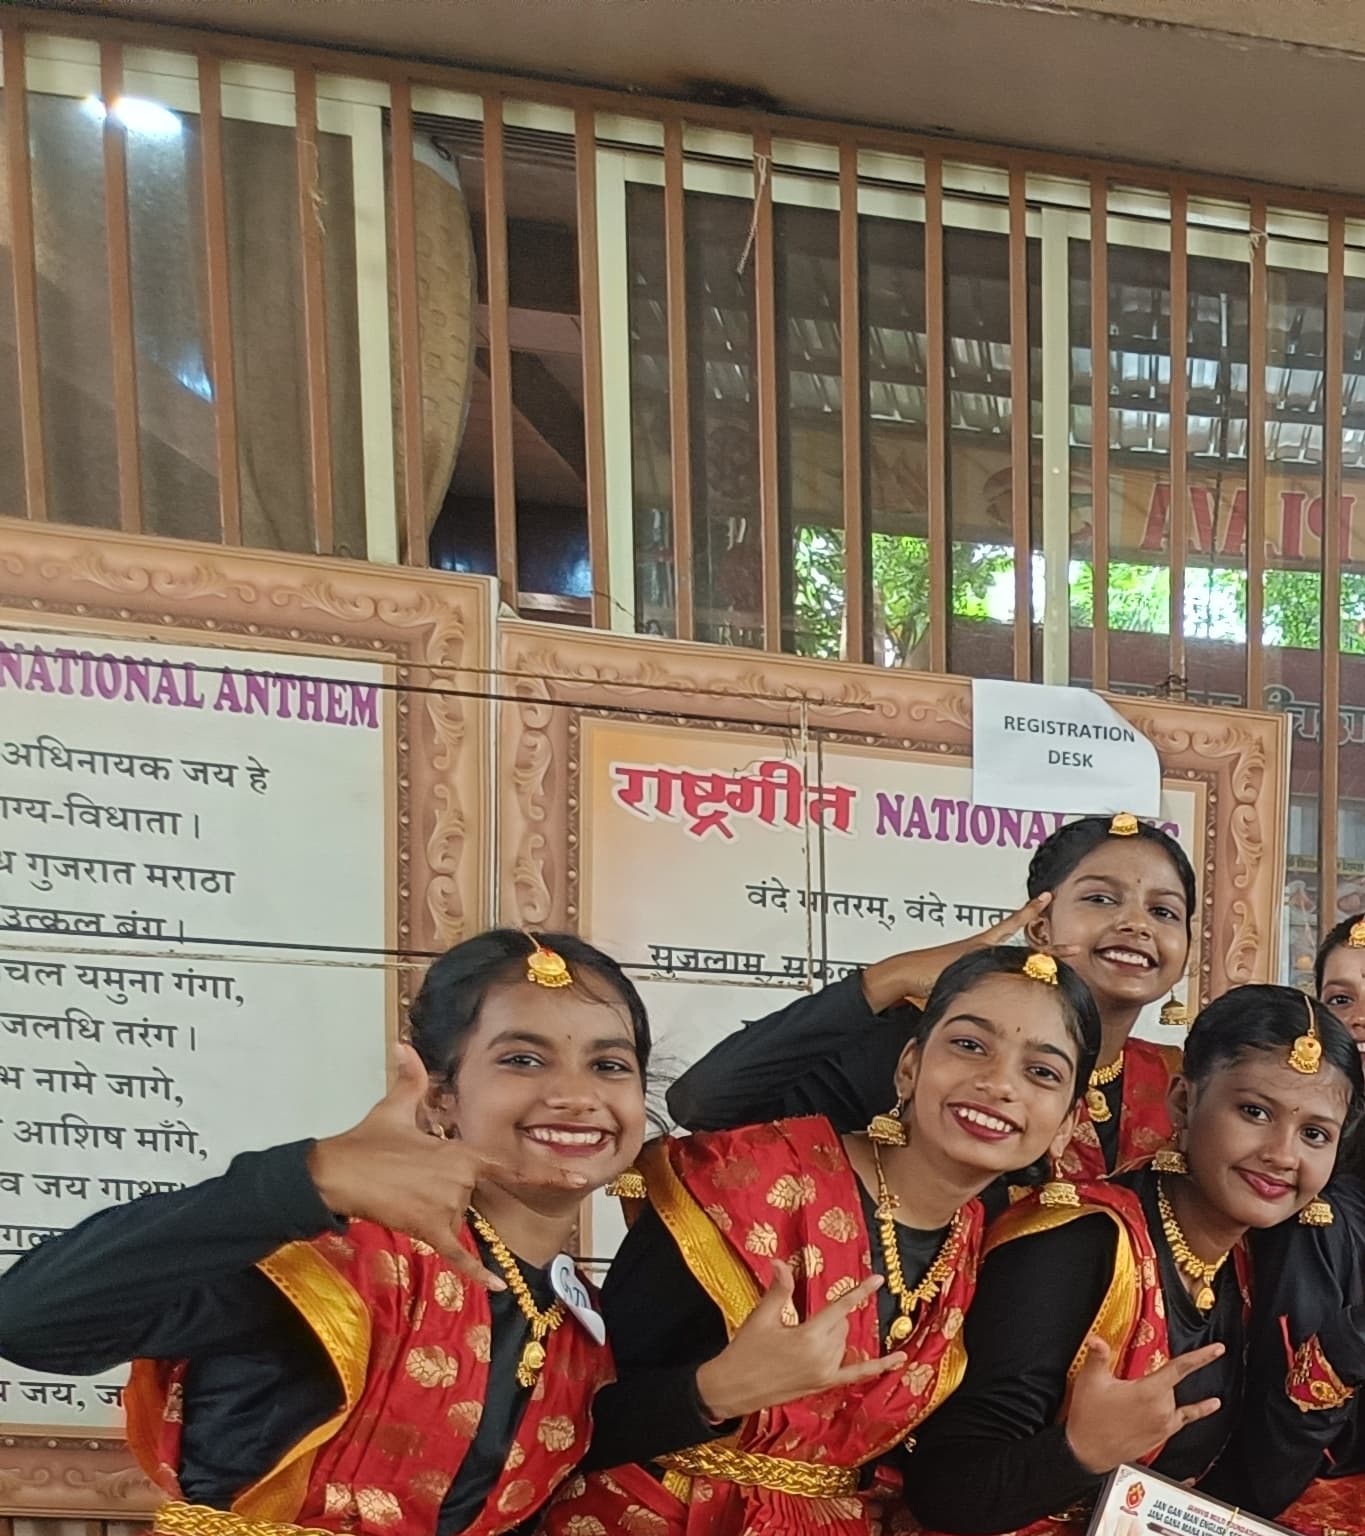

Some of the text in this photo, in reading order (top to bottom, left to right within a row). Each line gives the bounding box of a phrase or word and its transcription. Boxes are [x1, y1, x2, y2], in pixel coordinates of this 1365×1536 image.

[0, 641, 380, 729] NATIONAL ANTHEM
[1003, 715, 1136, 743] REGISTRATION
[2, 735, 269, 794] अधिनायक जय हे
[1048, 749, 1094, 768] DESK
[615, 760, 857, 839] राष्ट्रगीत
[25, 853, 136, 891] गुजरात
[144, 863, 236, 894] मराठा
[0, 904, 105, 934] उत्कल
[114, 910, 166, 937] बंग
[746, 877, 790, 913] वंदे
[904, 892, 946, 928] वंदे
[0, 958, 244, 1007] चल यमुना गंगा,
[0, 1008, 104, 1042] जलधि
[112, 1017, 178, 1048] तरंग
[33, 1061, 97, 1095] नामे
[105, 1067, 183, 1107] जागे,
[15, 1113, 207, 1160] आशिष माँगे,
[32, 1174, 90, 1199] जय
[18, 1380, 86, 1412] जय,
